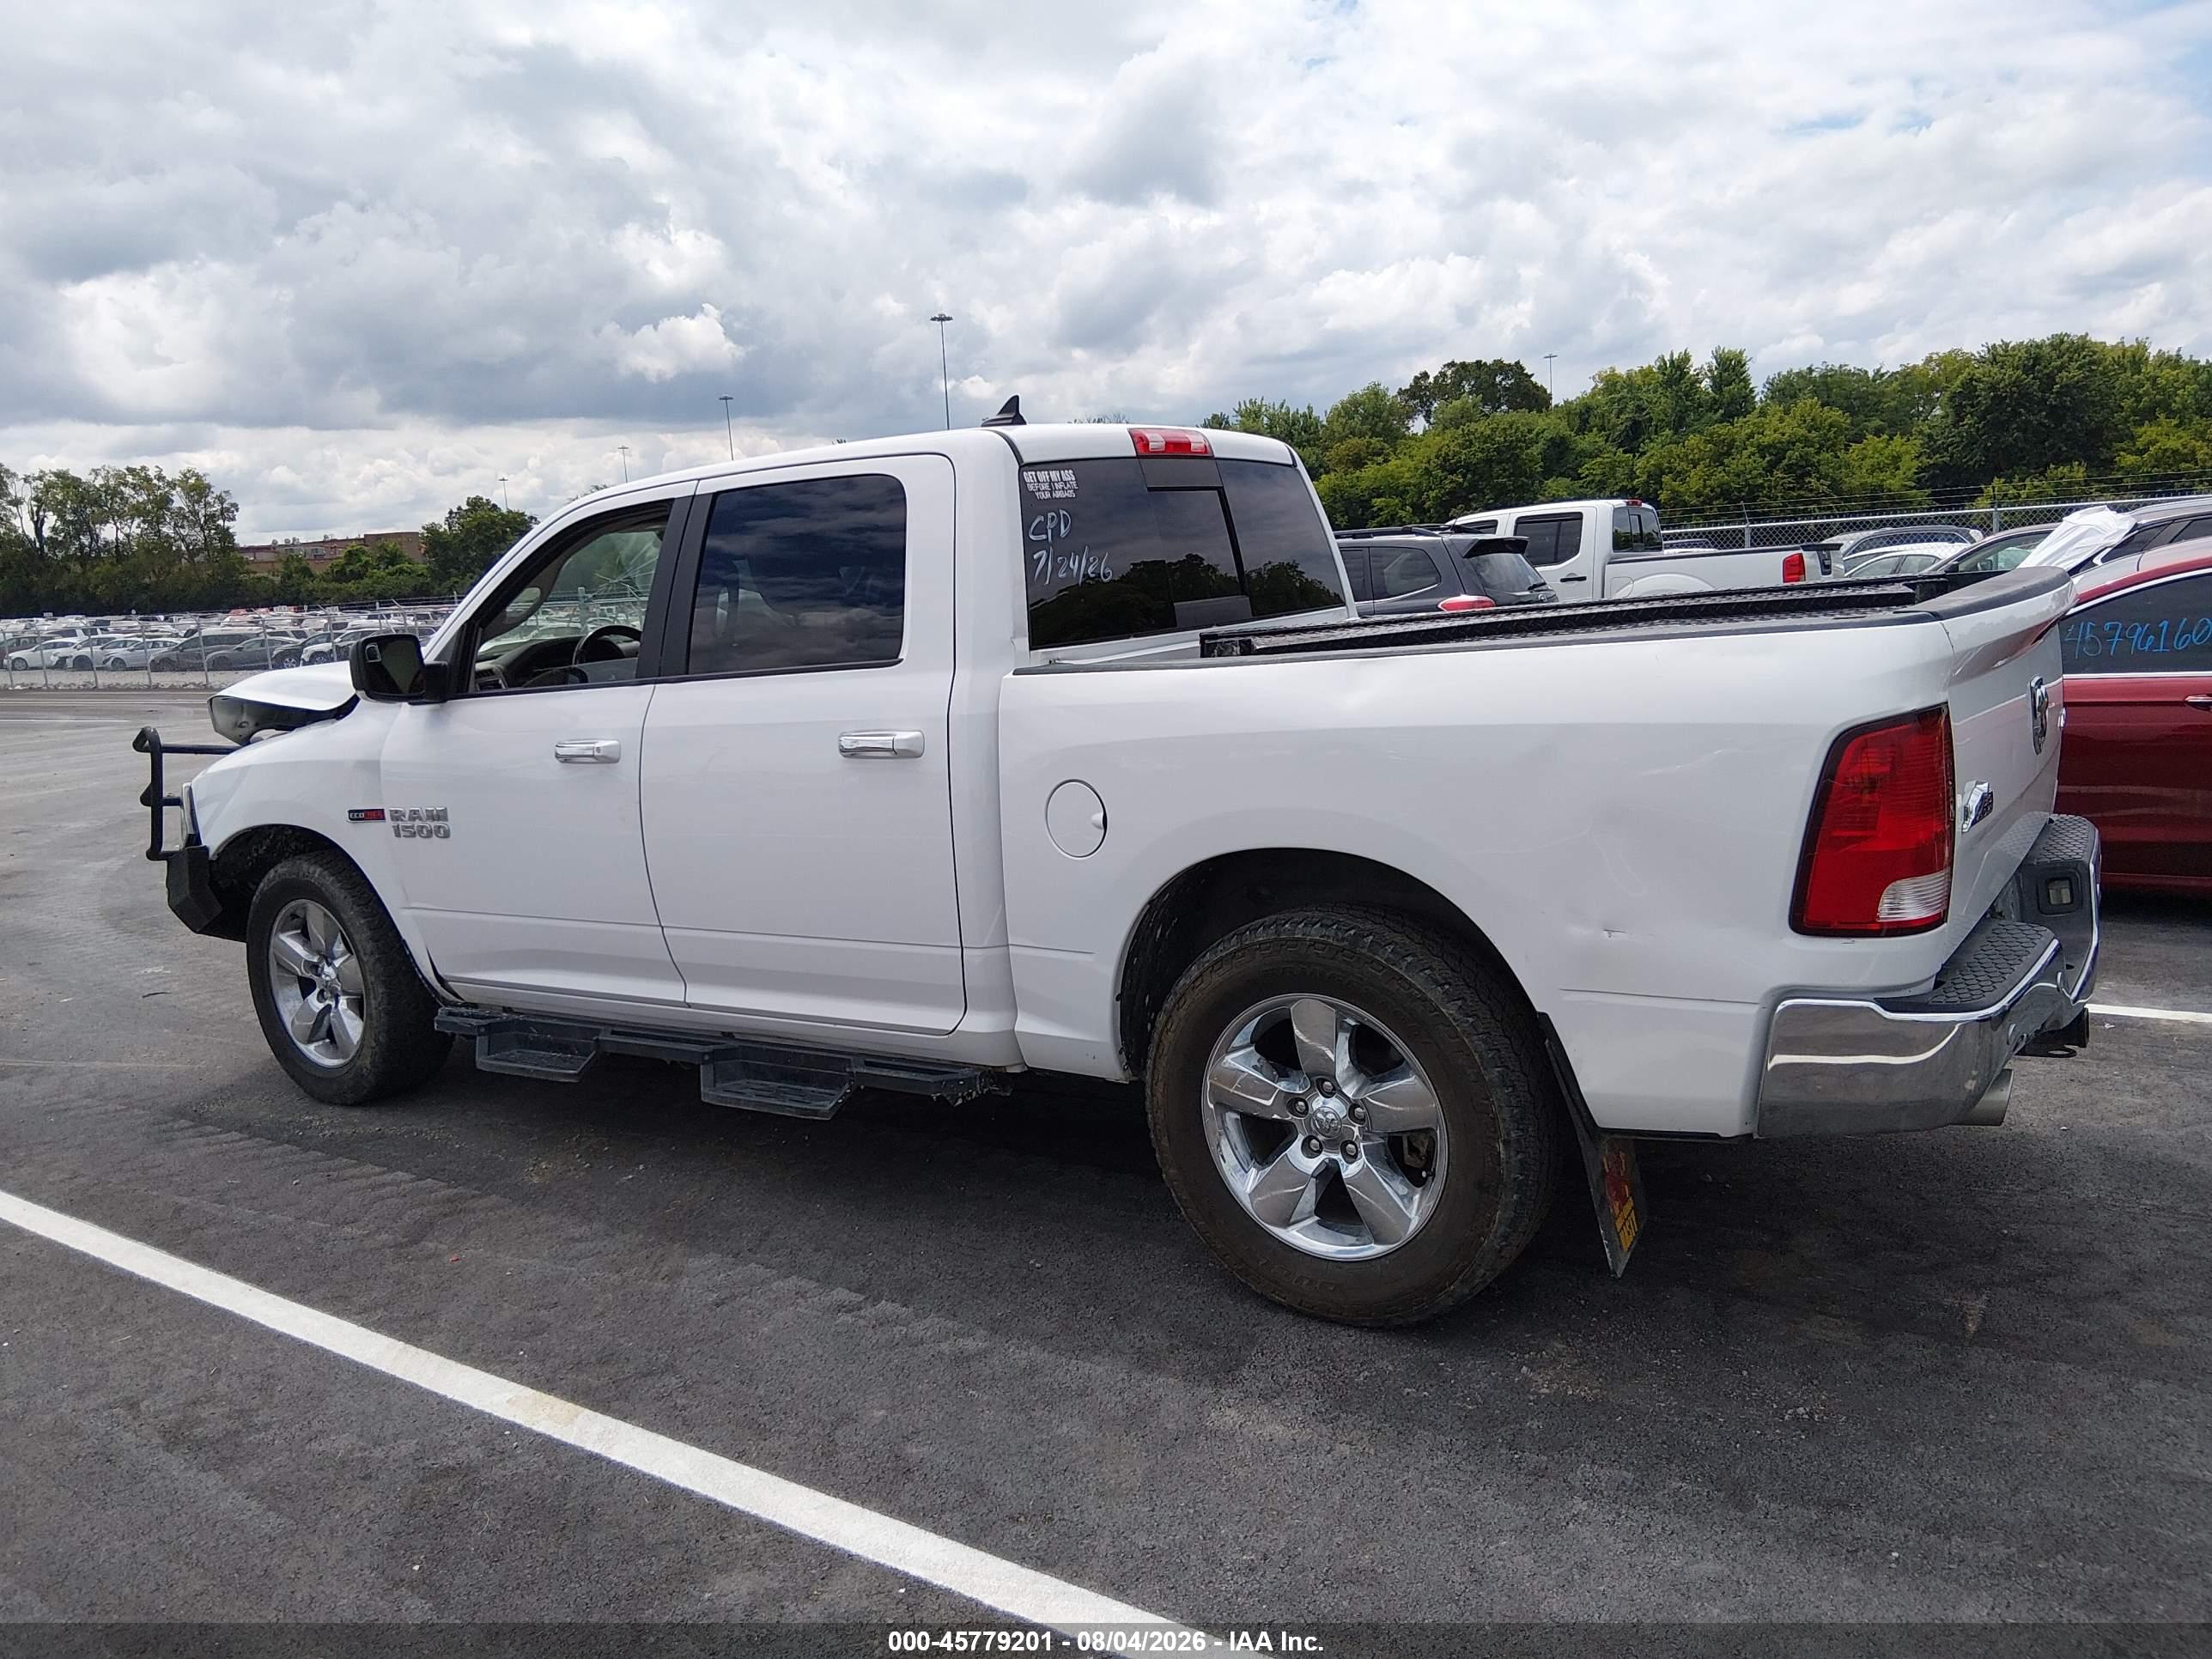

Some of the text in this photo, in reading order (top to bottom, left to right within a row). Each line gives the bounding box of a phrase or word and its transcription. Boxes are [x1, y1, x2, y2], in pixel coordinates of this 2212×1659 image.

[1023, 469, 1076, 483] GET OFF MY ASS
[1026, 483, 1052, 492] BEFORE
[1052, 489, 1076, 499] AIRBAGS
[1029, 509, 1071, 543] CPD
[1033, 545, 1113, 586] 7/24/26
[389, 807, 448, 822] RAM
[392, 823, 451, 839] 1500
